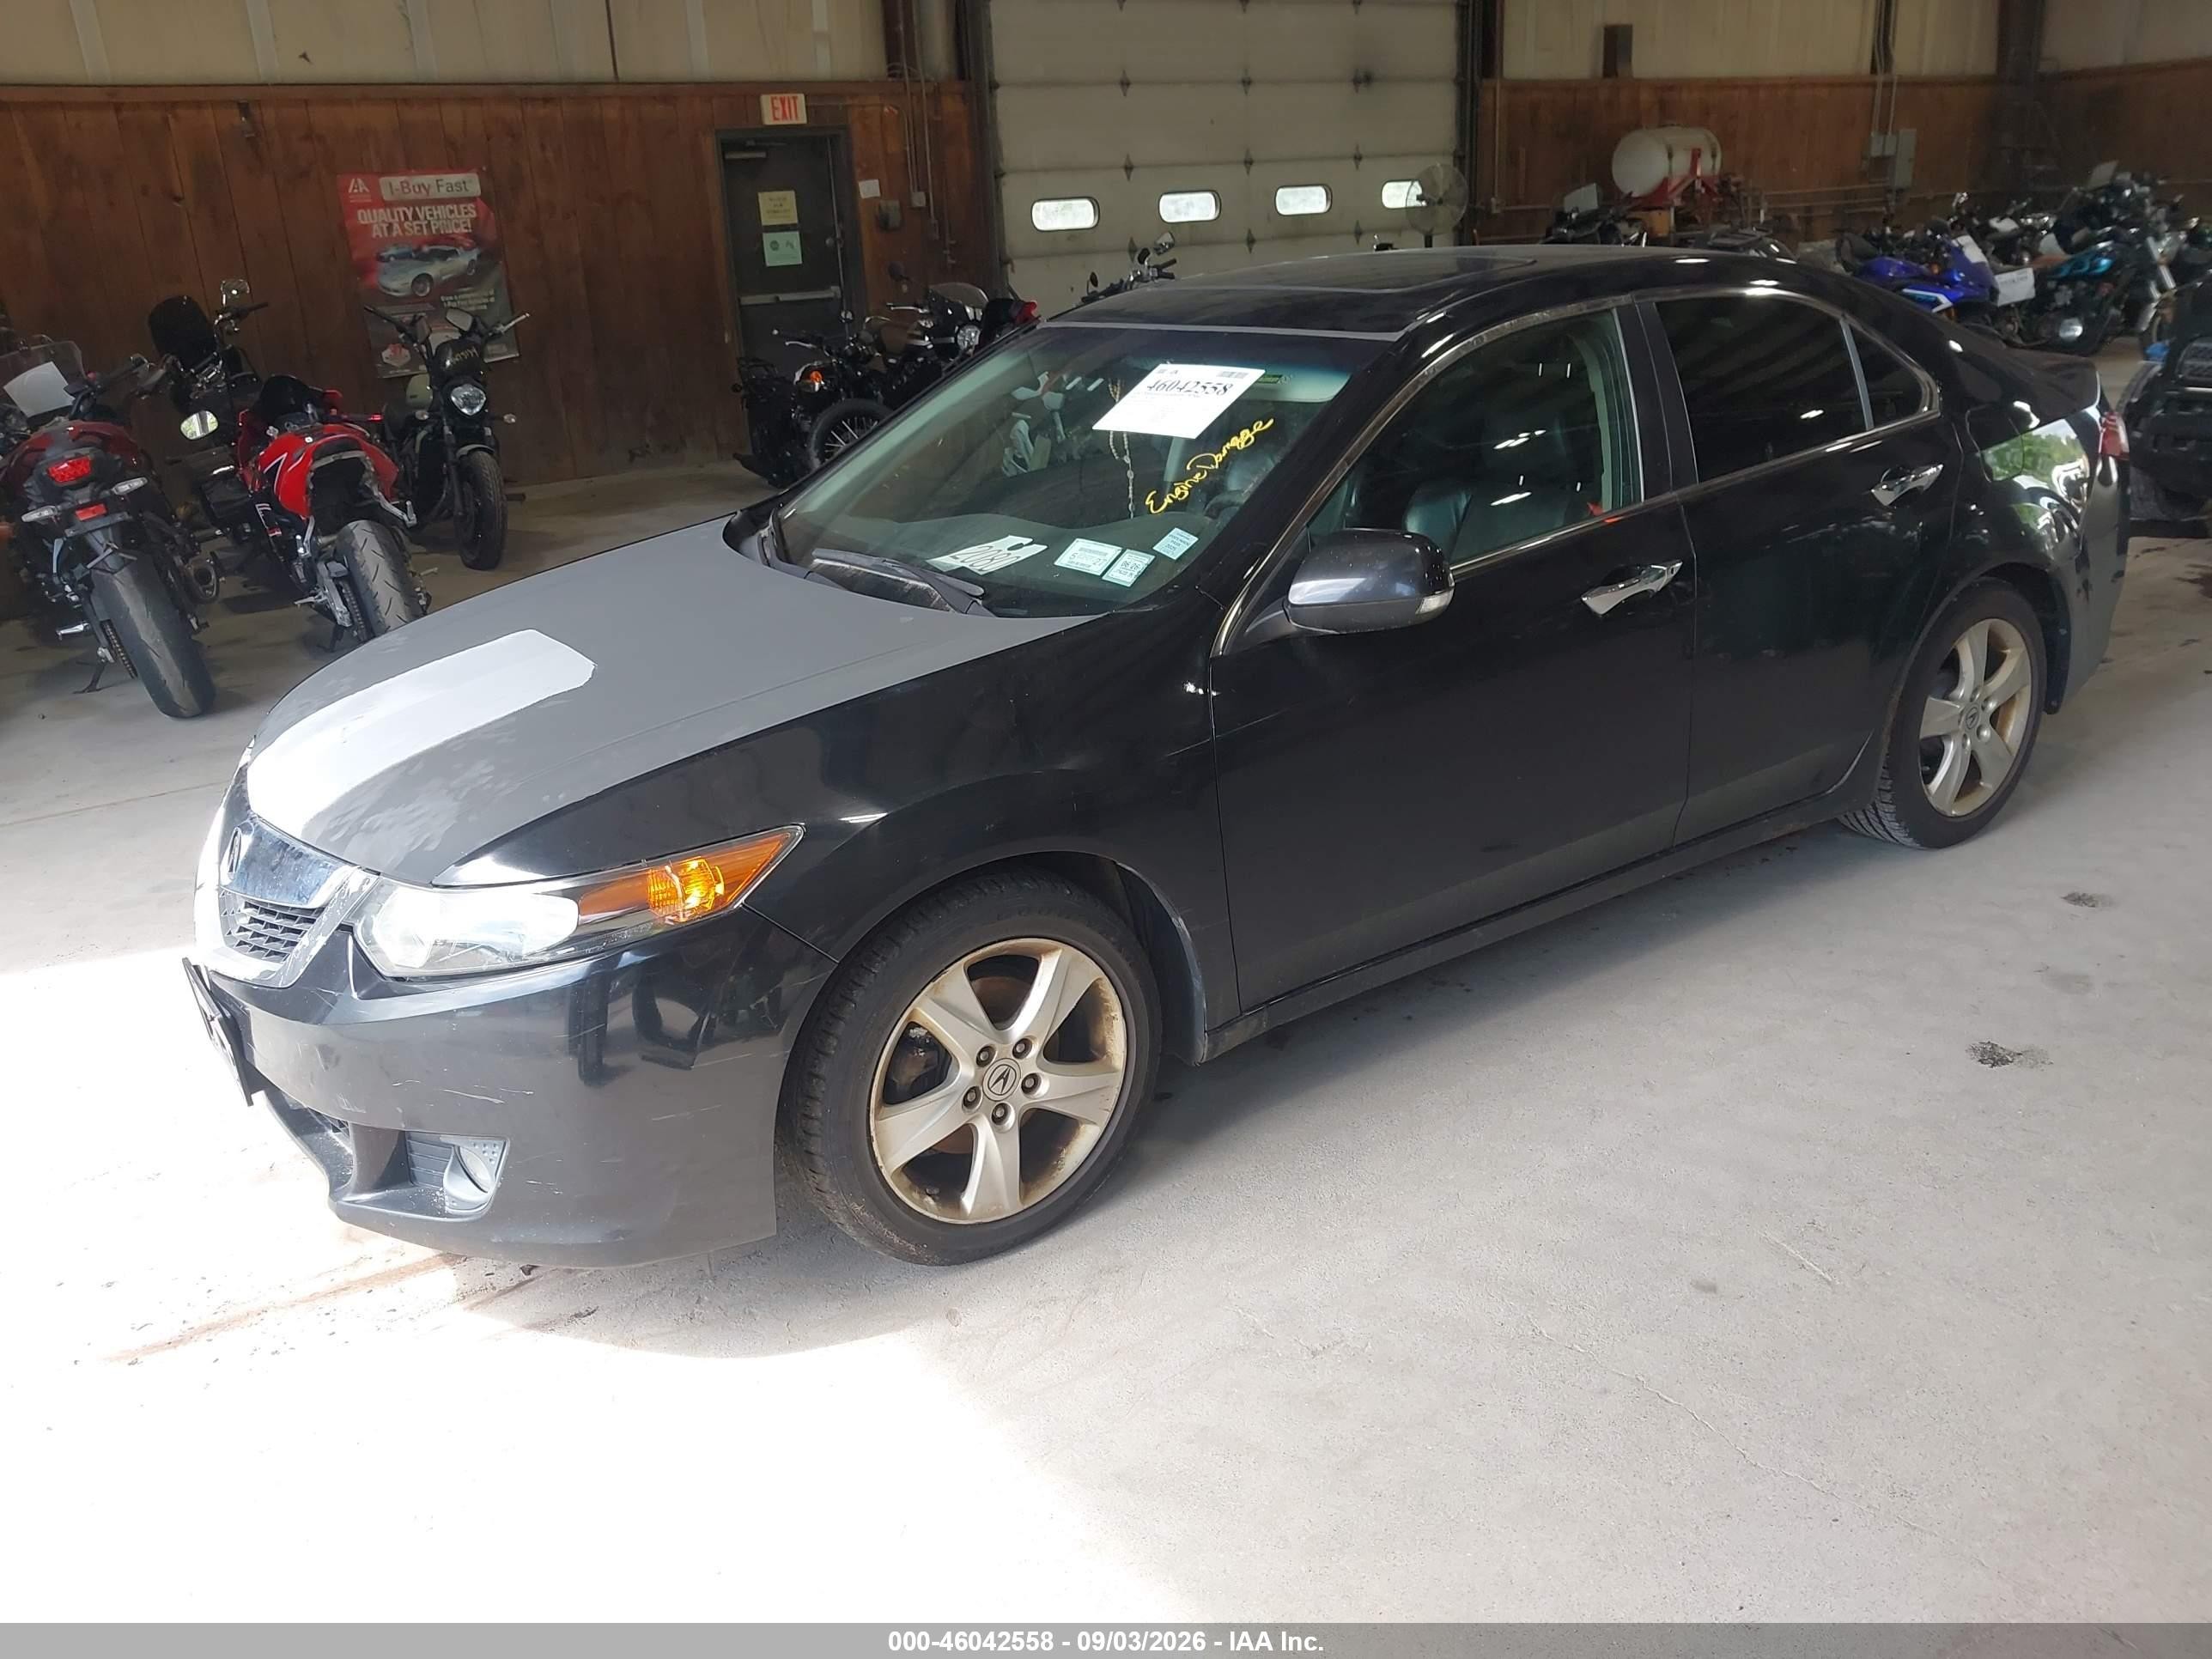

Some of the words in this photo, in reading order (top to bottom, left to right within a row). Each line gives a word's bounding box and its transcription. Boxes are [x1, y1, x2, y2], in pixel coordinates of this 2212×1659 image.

[770, 96, 799, 121] EXIT
[388, 178, 430, 197] I-Buy
[435, 178, 471, 193] Fast
[357, 207, 414, 224] QUALITY
[416, 204, 477, 221] VEHICLES
[372, 223, 390, 239] AT
[392, 222, 404, 237] A
[404, 221, 428, 236] SET
[431, 219, 472, 234] PRICE!
[1147, 379, 1234, 396] 46042558
[1145, 468, 1207, 514] Engine
[1186, 418, 1275, 471] Damage
